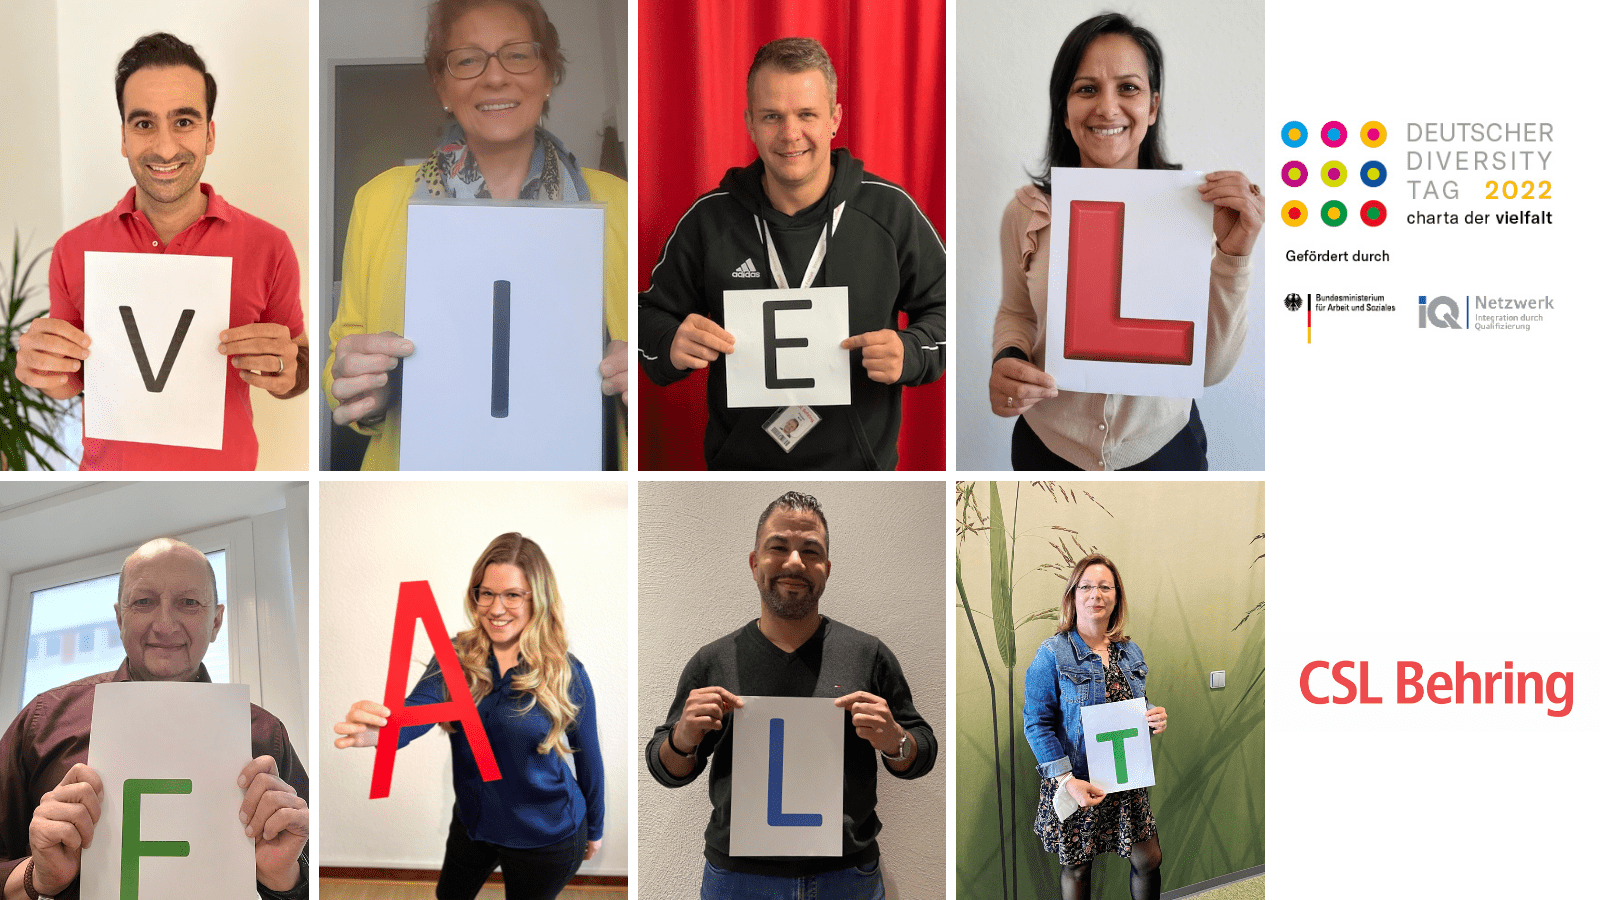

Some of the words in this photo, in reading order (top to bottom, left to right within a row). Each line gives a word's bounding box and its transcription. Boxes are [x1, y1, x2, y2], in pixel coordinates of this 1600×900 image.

[731, 271, 761, 279] adidas
[1063, 200, 1195, 365] L
[119, 305, 195, 393] V
[762, 299, 816, 390] E
[368, 580, 503, 800] A
[767, 718, 823, 827] L
[1095, 727, 1139, 785] T
[119, 778, 193, 900] F
